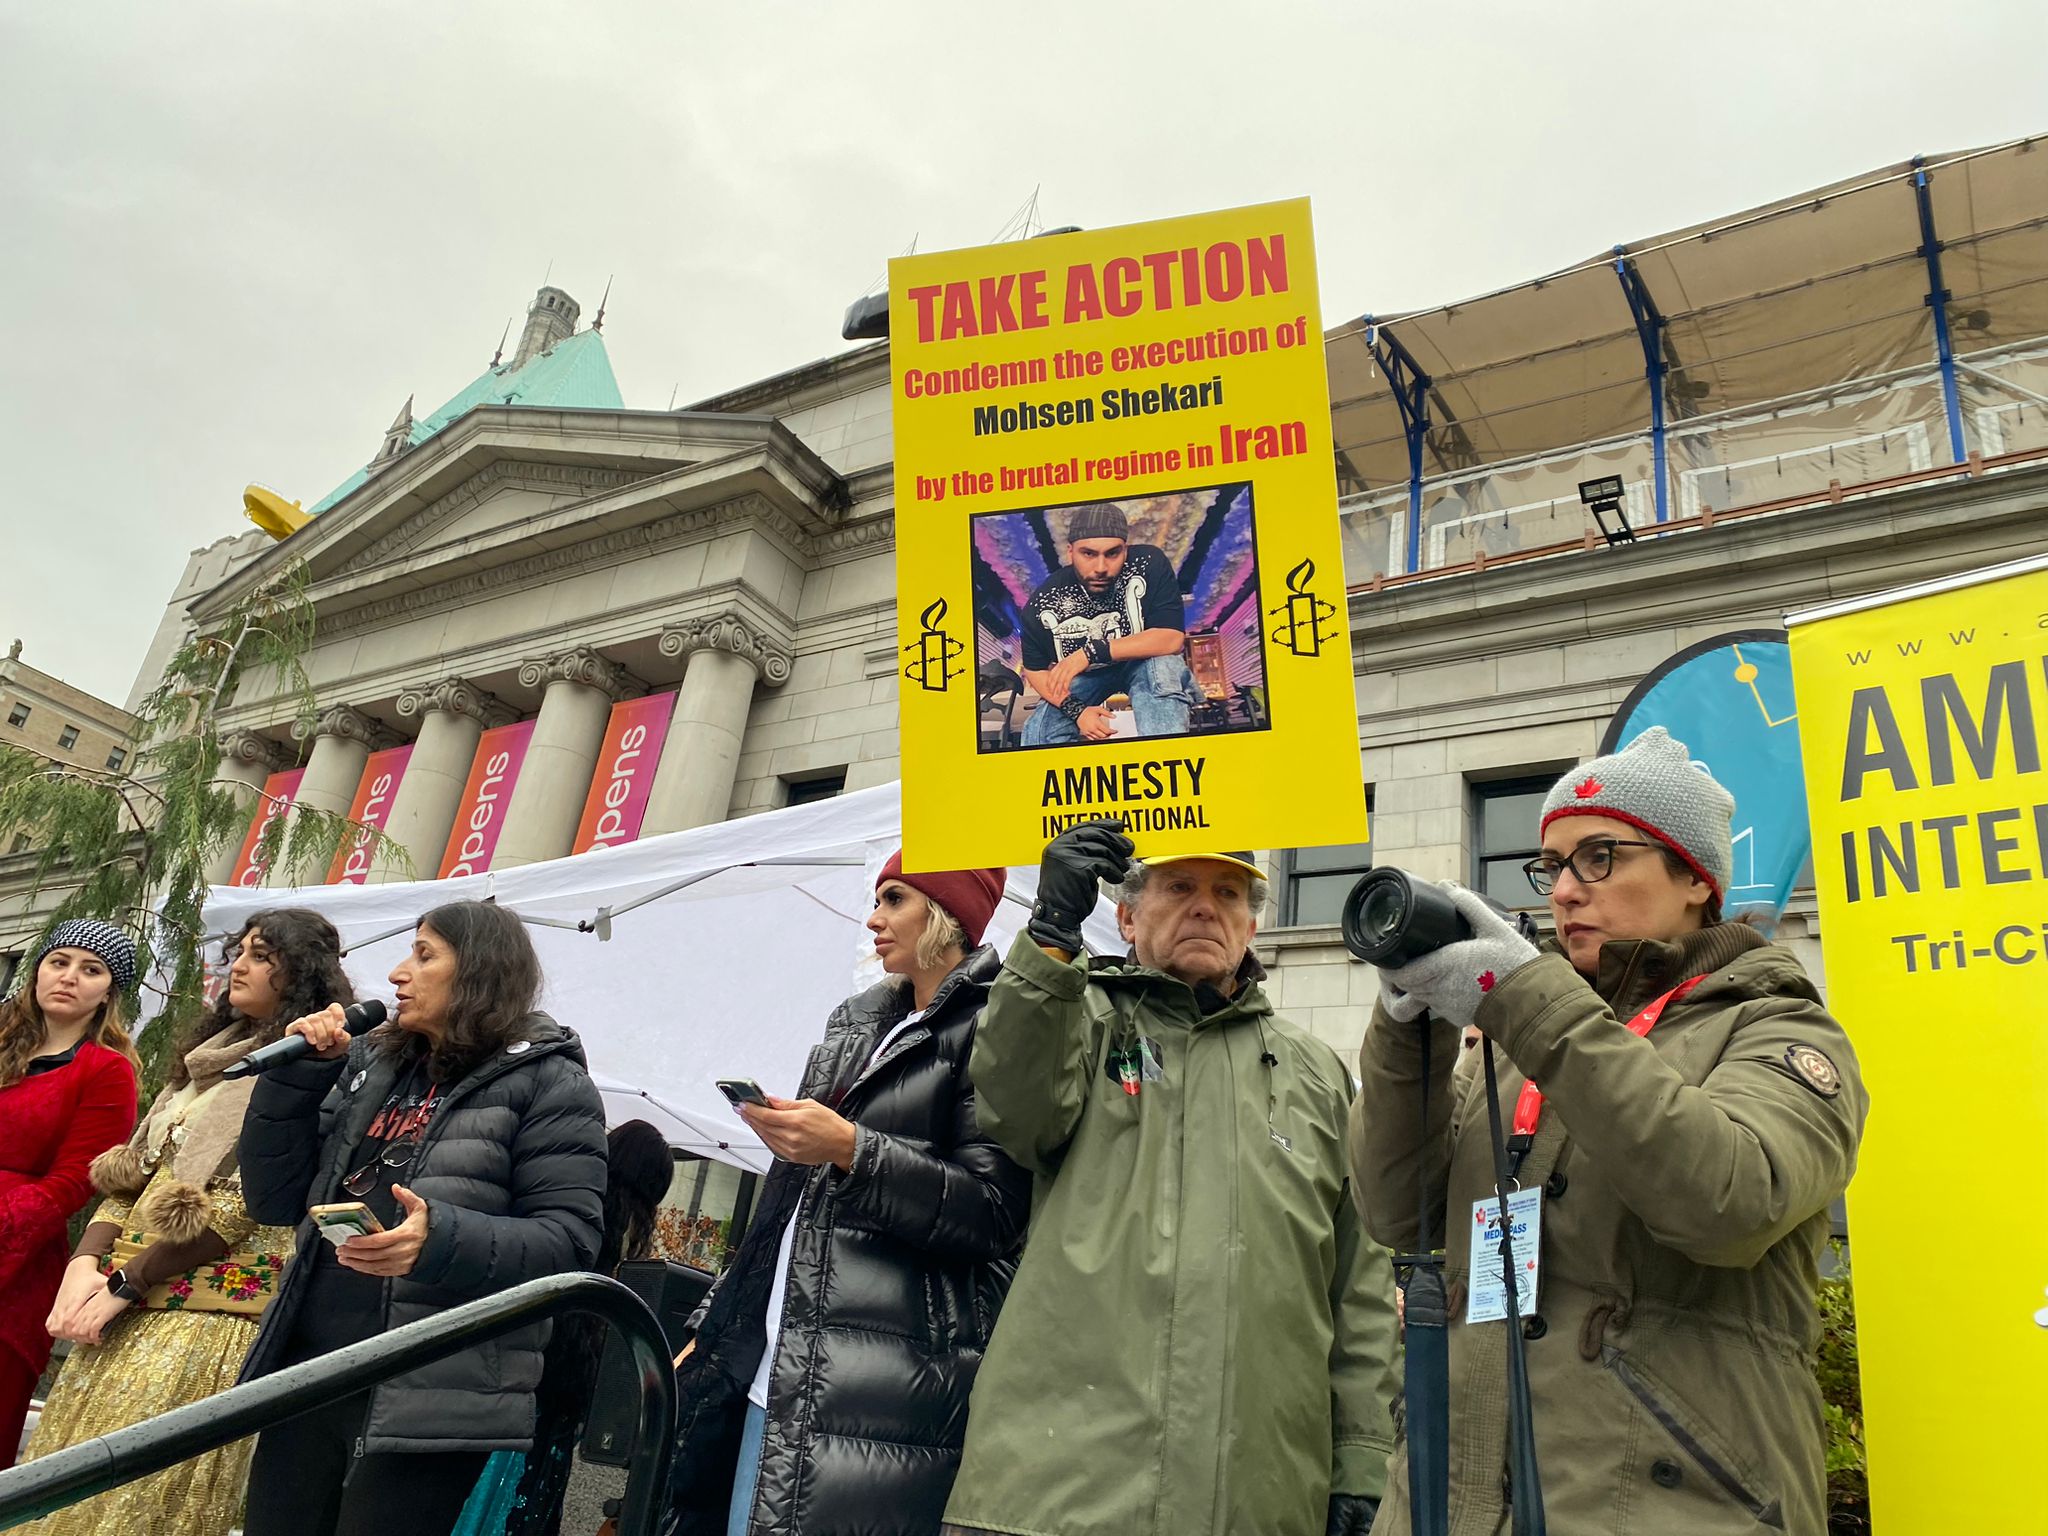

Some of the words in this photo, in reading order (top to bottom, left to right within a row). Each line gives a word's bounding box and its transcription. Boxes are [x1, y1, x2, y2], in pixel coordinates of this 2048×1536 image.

[908, 270, 1050, 343] TAKE
[1063, 234, 1289, 325] ACTION
[904, 358, 1047, 398] Condemn
[1053, 350, 1104, 379] the
[1110, 327, 1269, 372] execution
[1276, 316, 1307, 349] of
[974, 398, 1095, 436] Mohsen
[1102, 375, 1223, 419] Shekari
[916, 475, 947, 502] by
[952, 470, 994, 496] the
[1000, 458, 1079, 491] brutal
[1085, 450, 1181, 482] regime
[1188, 443, 1214, 468] in
[1220, 421, 1308, 465] Iran
[1840, 655, 2048, 803] AM
[587, 724, 647, 853] pens
[1041, 757, 1206, 808] AMNESTY
[338, 773, 392, 885] pens
[1484, 1228, 1505, 1240] MEDI
